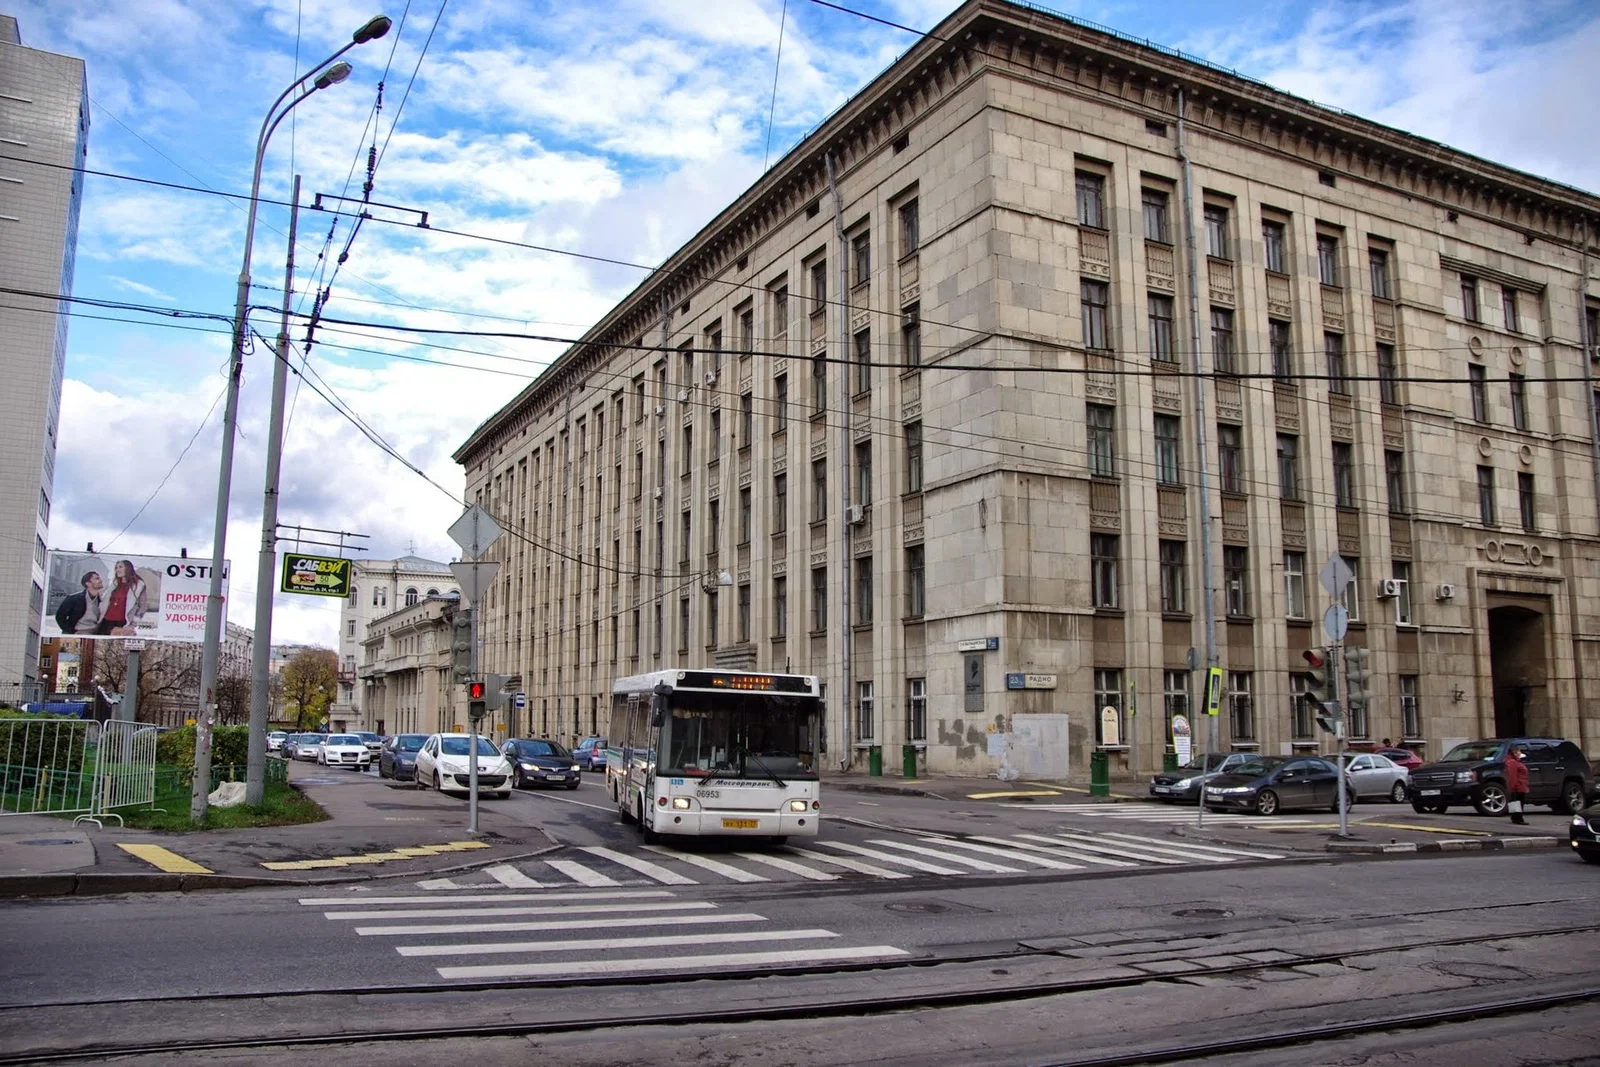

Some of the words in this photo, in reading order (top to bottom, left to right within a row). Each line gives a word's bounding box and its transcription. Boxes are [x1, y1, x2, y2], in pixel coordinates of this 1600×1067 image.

[293, 559, 346, 573] САБВЭЙ
[1010, 676, 1019, 684] 23
[715, 780, 771, 788] Мосгортранс
[696, 790, 720, 799] 06953
